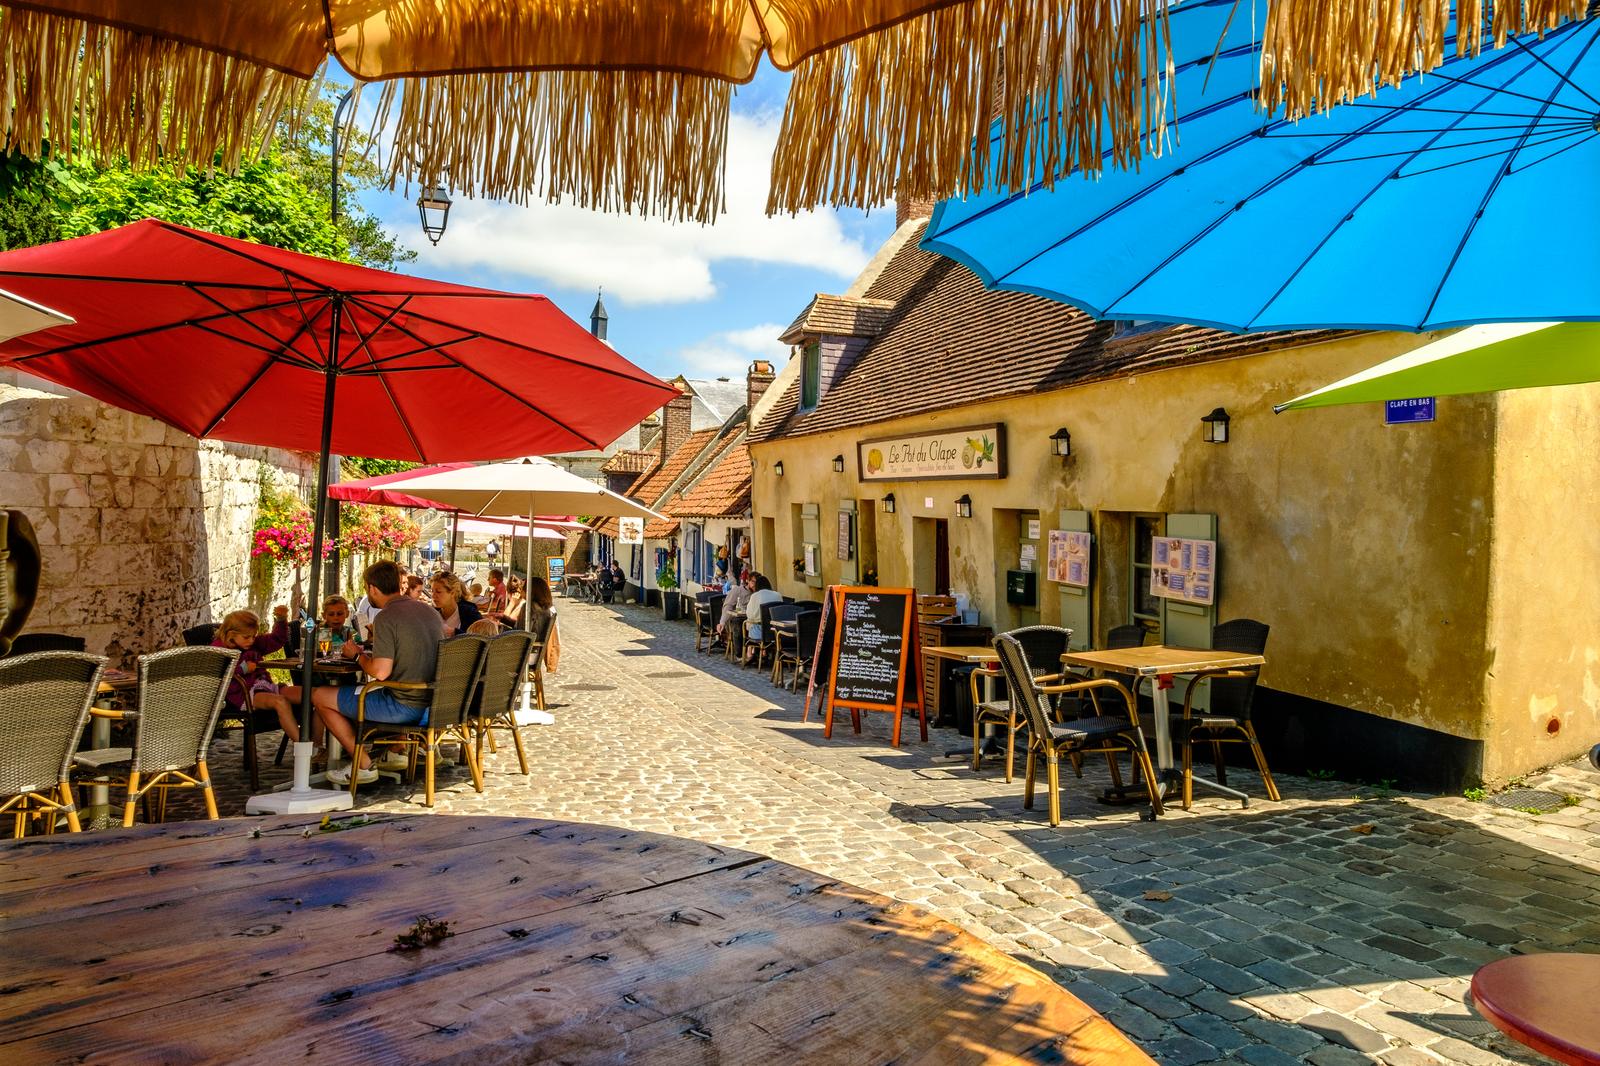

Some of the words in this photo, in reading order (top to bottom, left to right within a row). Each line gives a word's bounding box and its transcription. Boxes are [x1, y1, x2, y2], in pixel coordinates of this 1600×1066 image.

[888, 444, 900, 463] Le
[901, 444, 915, 463] Pot
[916, 442, 927, 462] du
[929, 440, 957, 463] Clape
